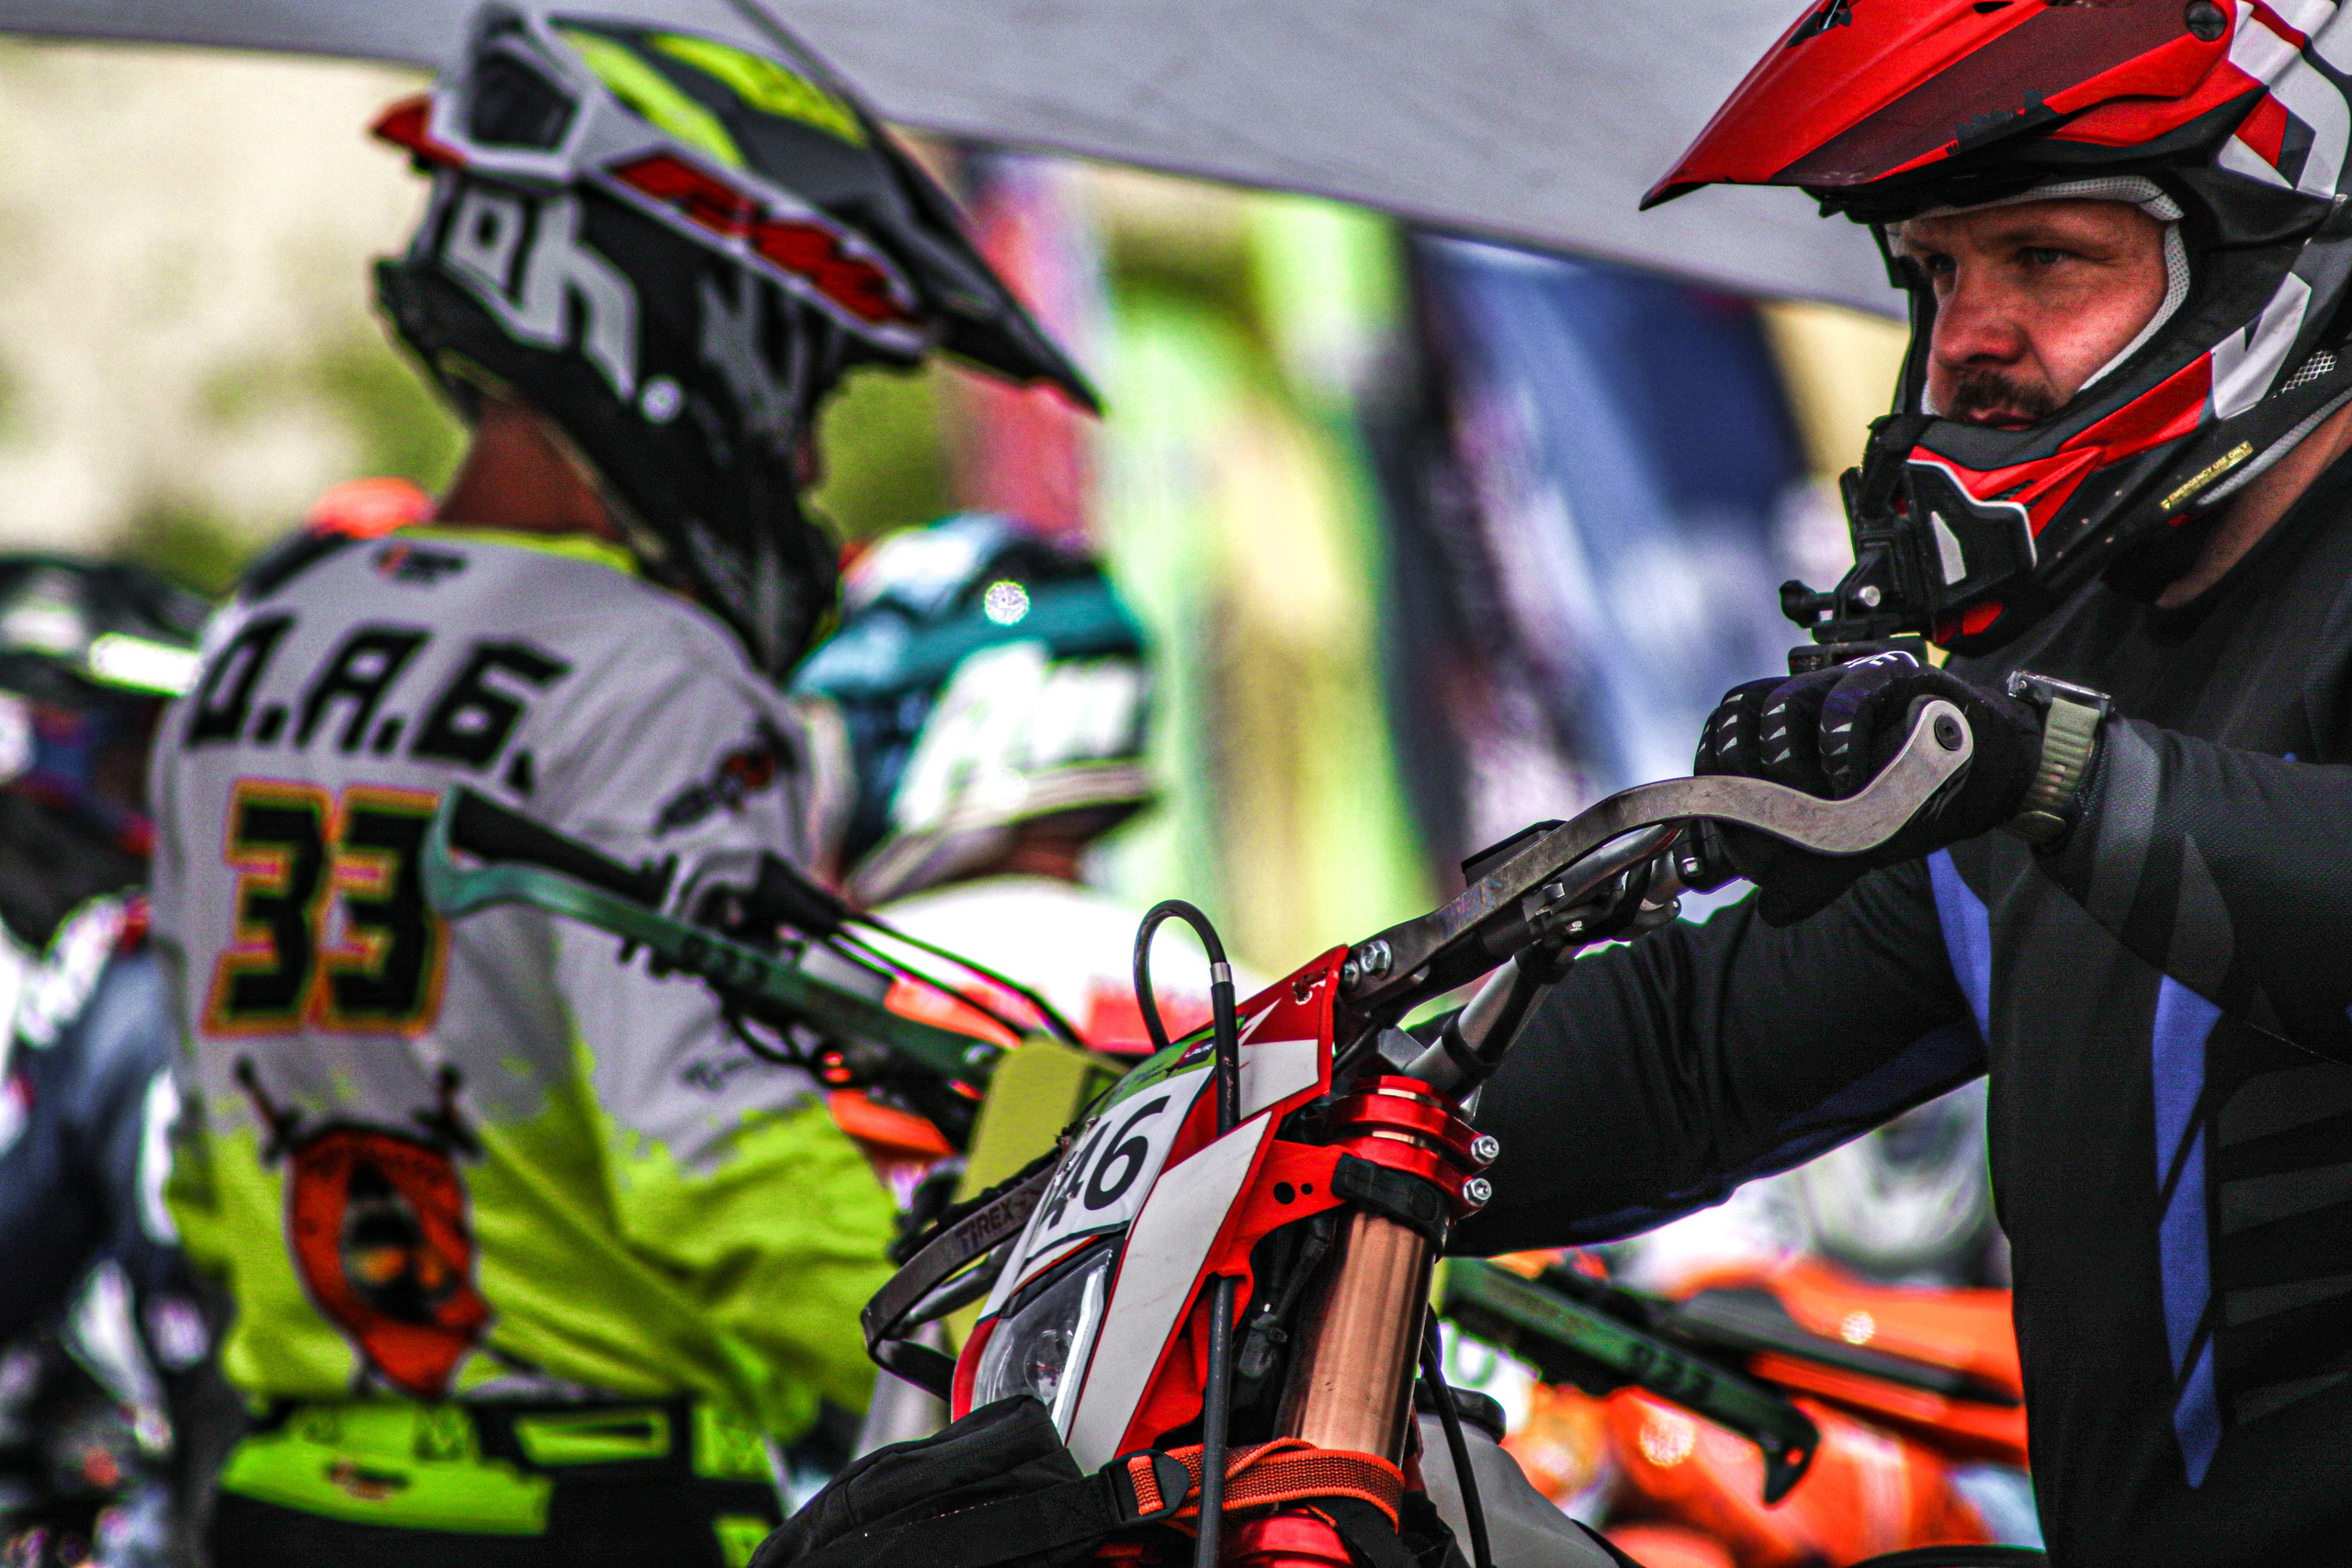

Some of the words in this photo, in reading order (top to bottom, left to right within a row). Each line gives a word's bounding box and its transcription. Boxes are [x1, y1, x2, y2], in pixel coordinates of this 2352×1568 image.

[2167, 465, 2212, 502] EMERGENCY
[2211, 455, 2229, 470] USE
[2227, 441, 2249, 459] ONLY
[193, 777, 452, 1037] 33
